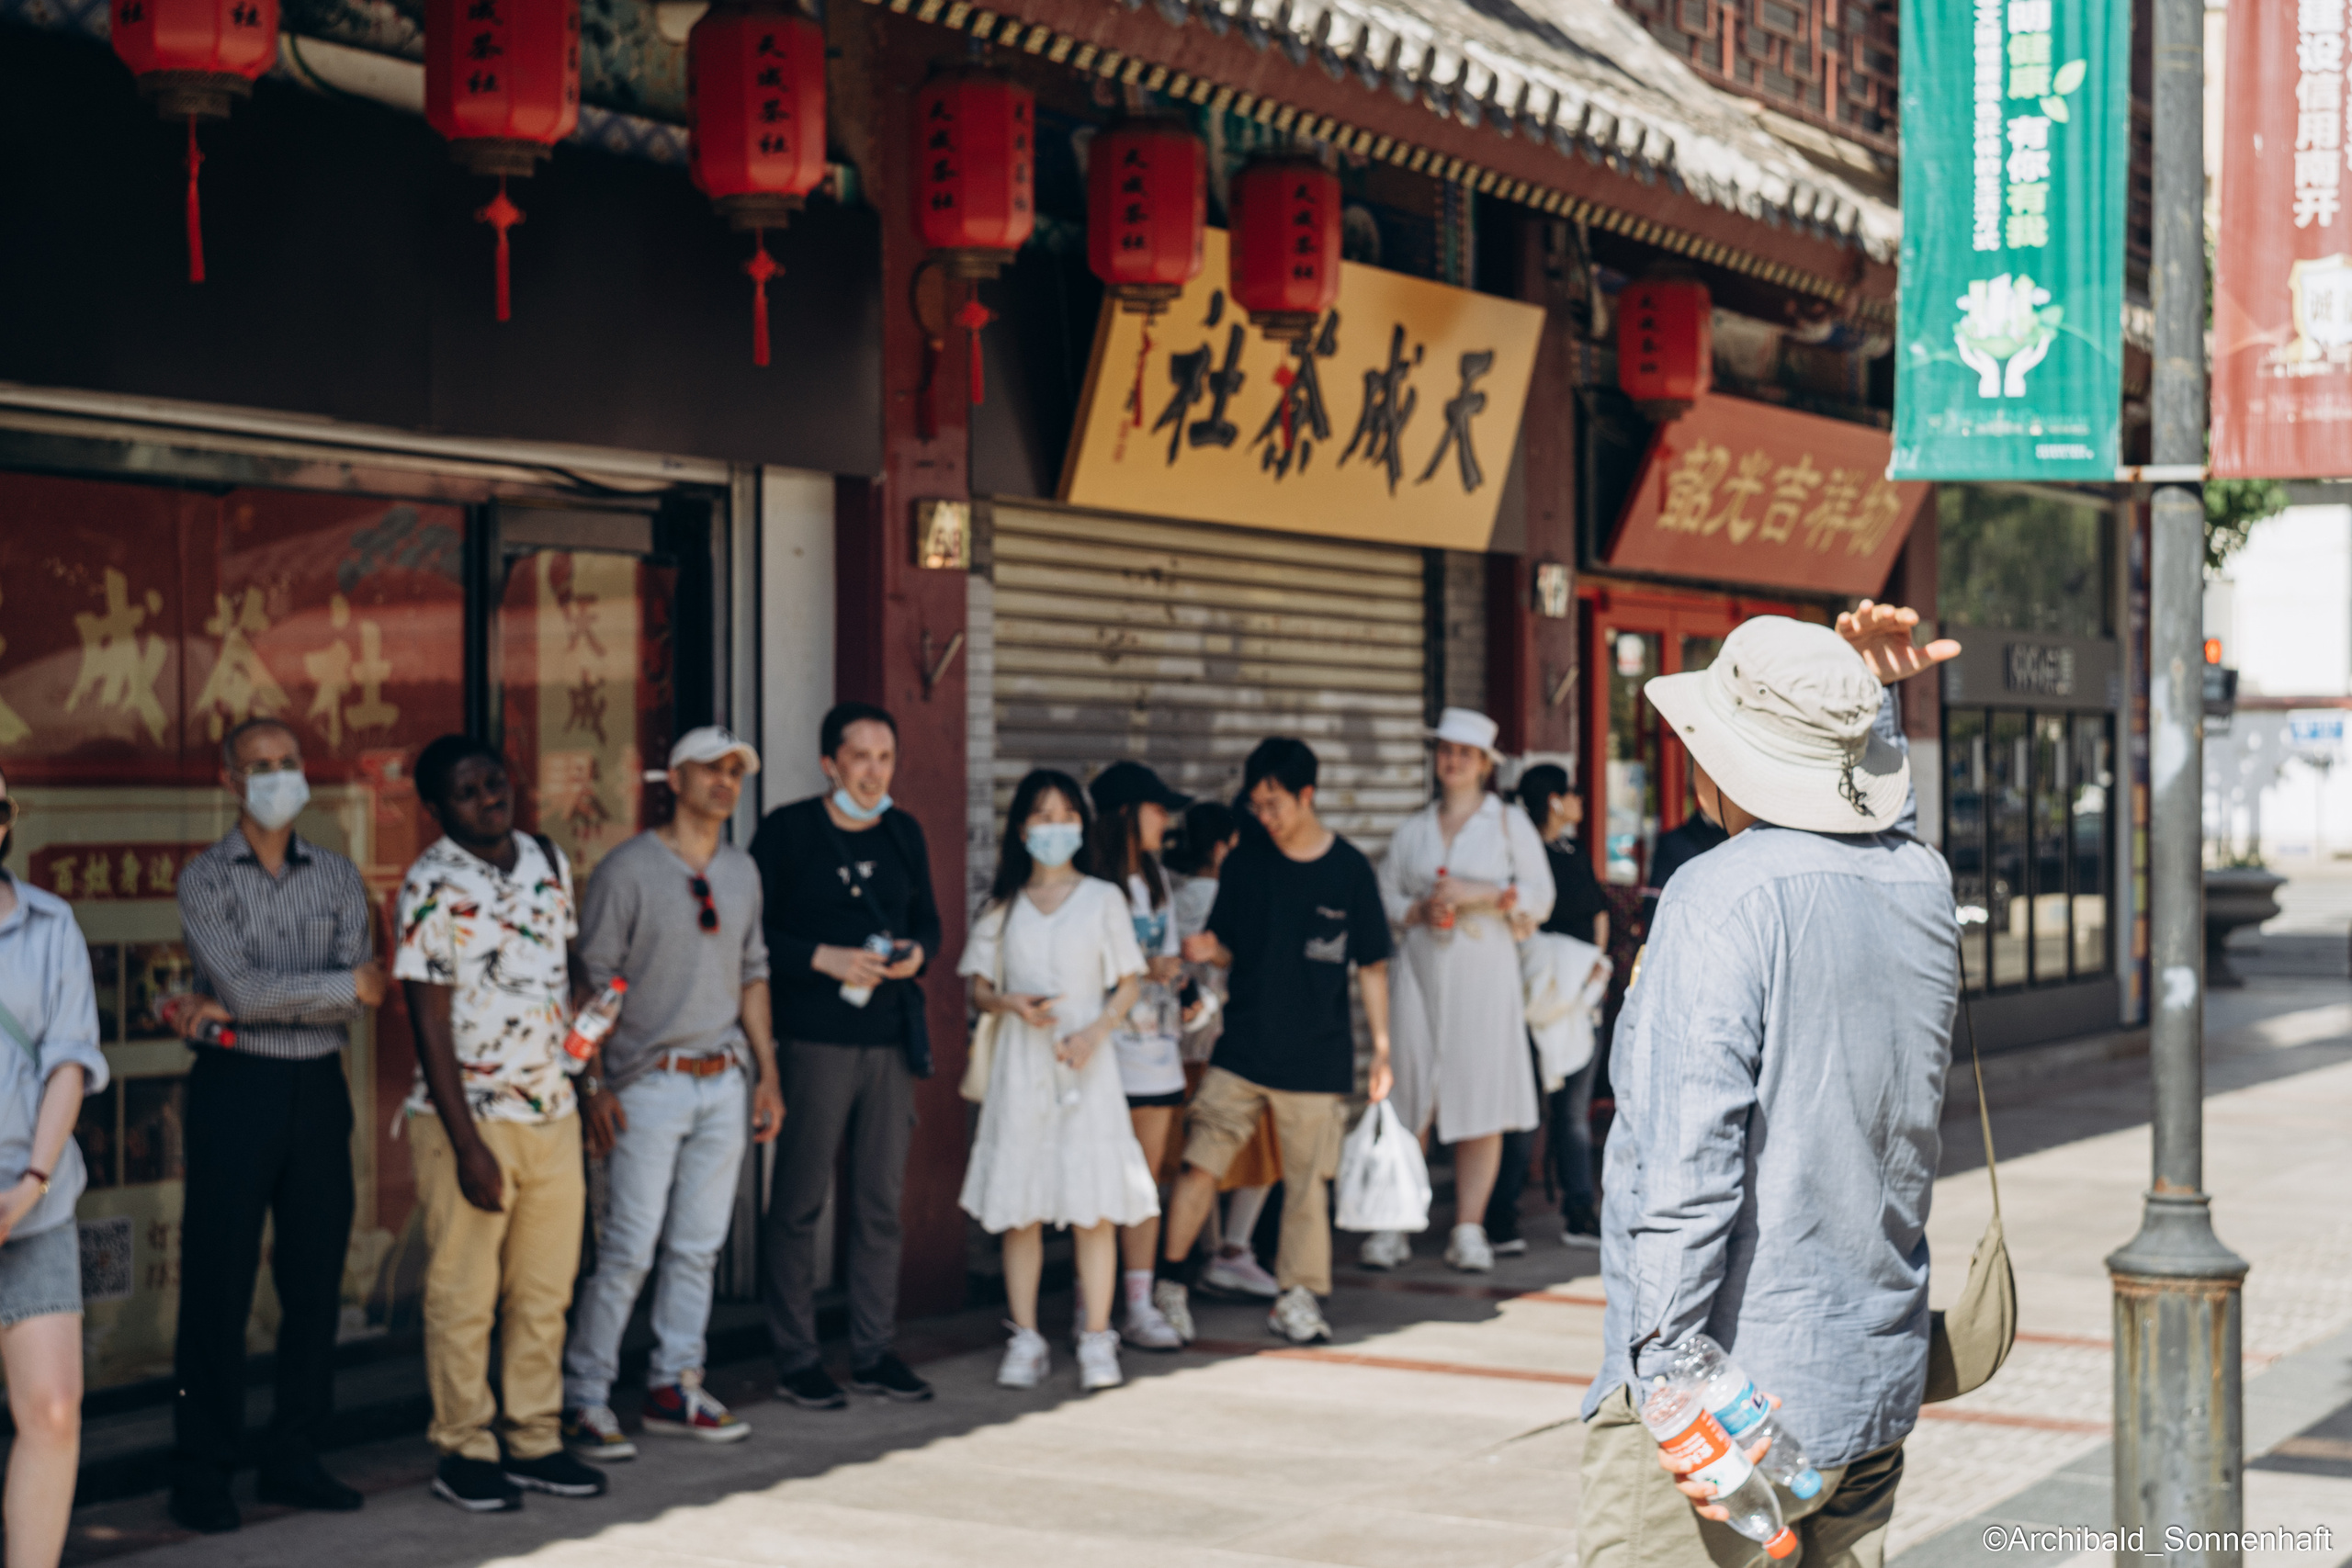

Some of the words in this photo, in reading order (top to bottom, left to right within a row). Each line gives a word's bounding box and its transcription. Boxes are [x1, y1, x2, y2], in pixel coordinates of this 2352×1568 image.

[0, 566, 401, 748] 成茶社
[560, 590, 610, 863] 天成茶
[48, 848, 193, 899] 百姓身边
